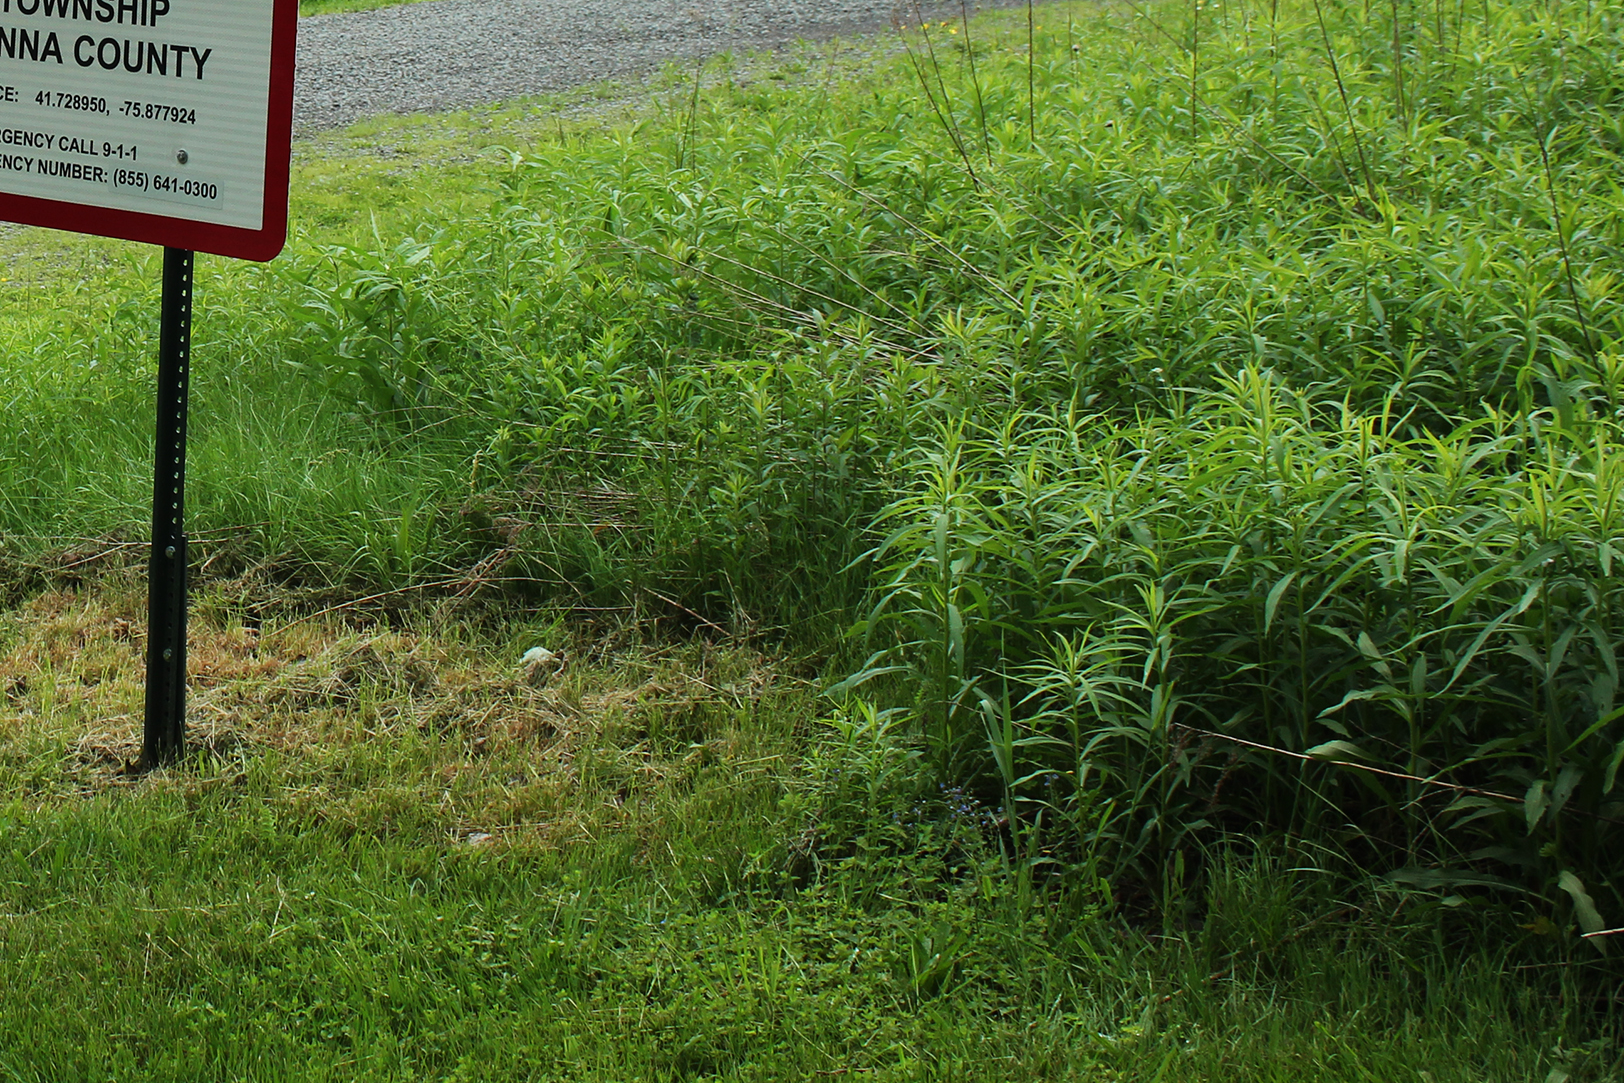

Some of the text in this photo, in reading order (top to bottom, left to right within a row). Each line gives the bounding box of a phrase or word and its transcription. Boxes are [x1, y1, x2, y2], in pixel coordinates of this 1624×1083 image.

[73, 34, 213, 81] COUNTY
[34, 90, 110, 117] 41.728950,
[118, 100, 196, 125] -75.877924
[58, 135, 99, 156] CALL
[102, 141, 137, 161] 9-1-1
[37, 158, 108, 184] NUMBER:
[113, 167, 149, 193] (855)
[153, 174, 218, 200] 641-0300
